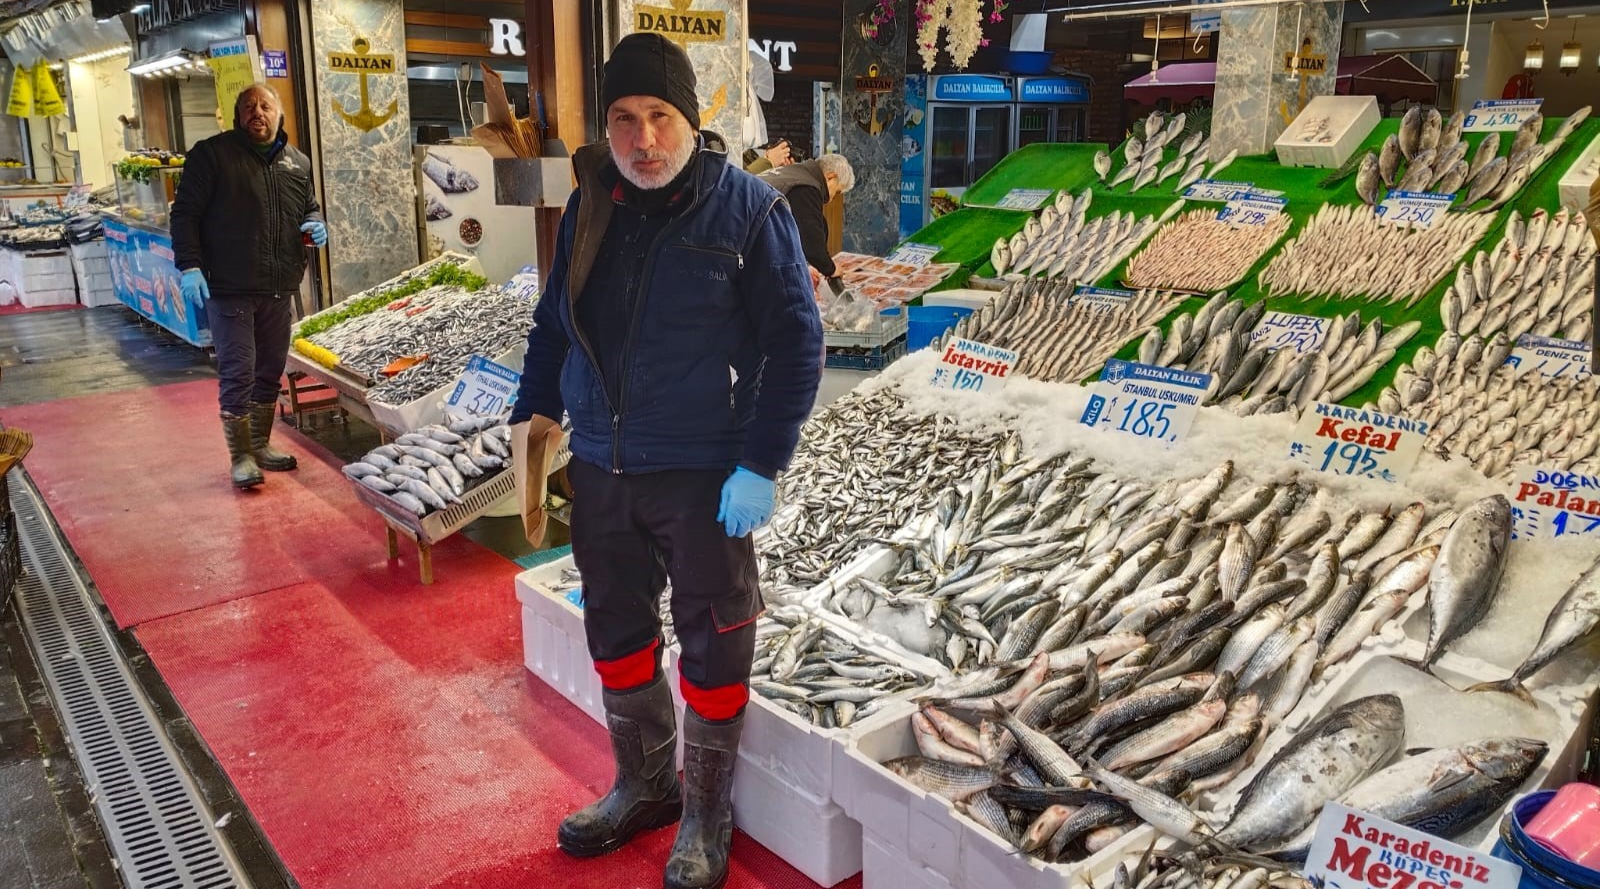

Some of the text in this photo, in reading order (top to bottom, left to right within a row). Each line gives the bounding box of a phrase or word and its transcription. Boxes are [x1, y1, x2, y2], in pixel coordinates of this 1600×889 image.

[637, 12, 722, 36] DALYAN
[331, 56, 391, 69] DALYAN
[856, 79, 892, 90] DALYAN
[943, 82, 971, 94] DALYAN
[1025, 84, 1051, 95] DALYAN
[1548, 339, 1583, 350] DALYAN
[1134, 367, 1202, 386] DALYAN BALIK
[1122, 381, 1200, 406] İSTANBUL USKUMRU
[1316, 417, 1402, 451] Kefal
[1342, 813, 1490, 883] Karadeniz
